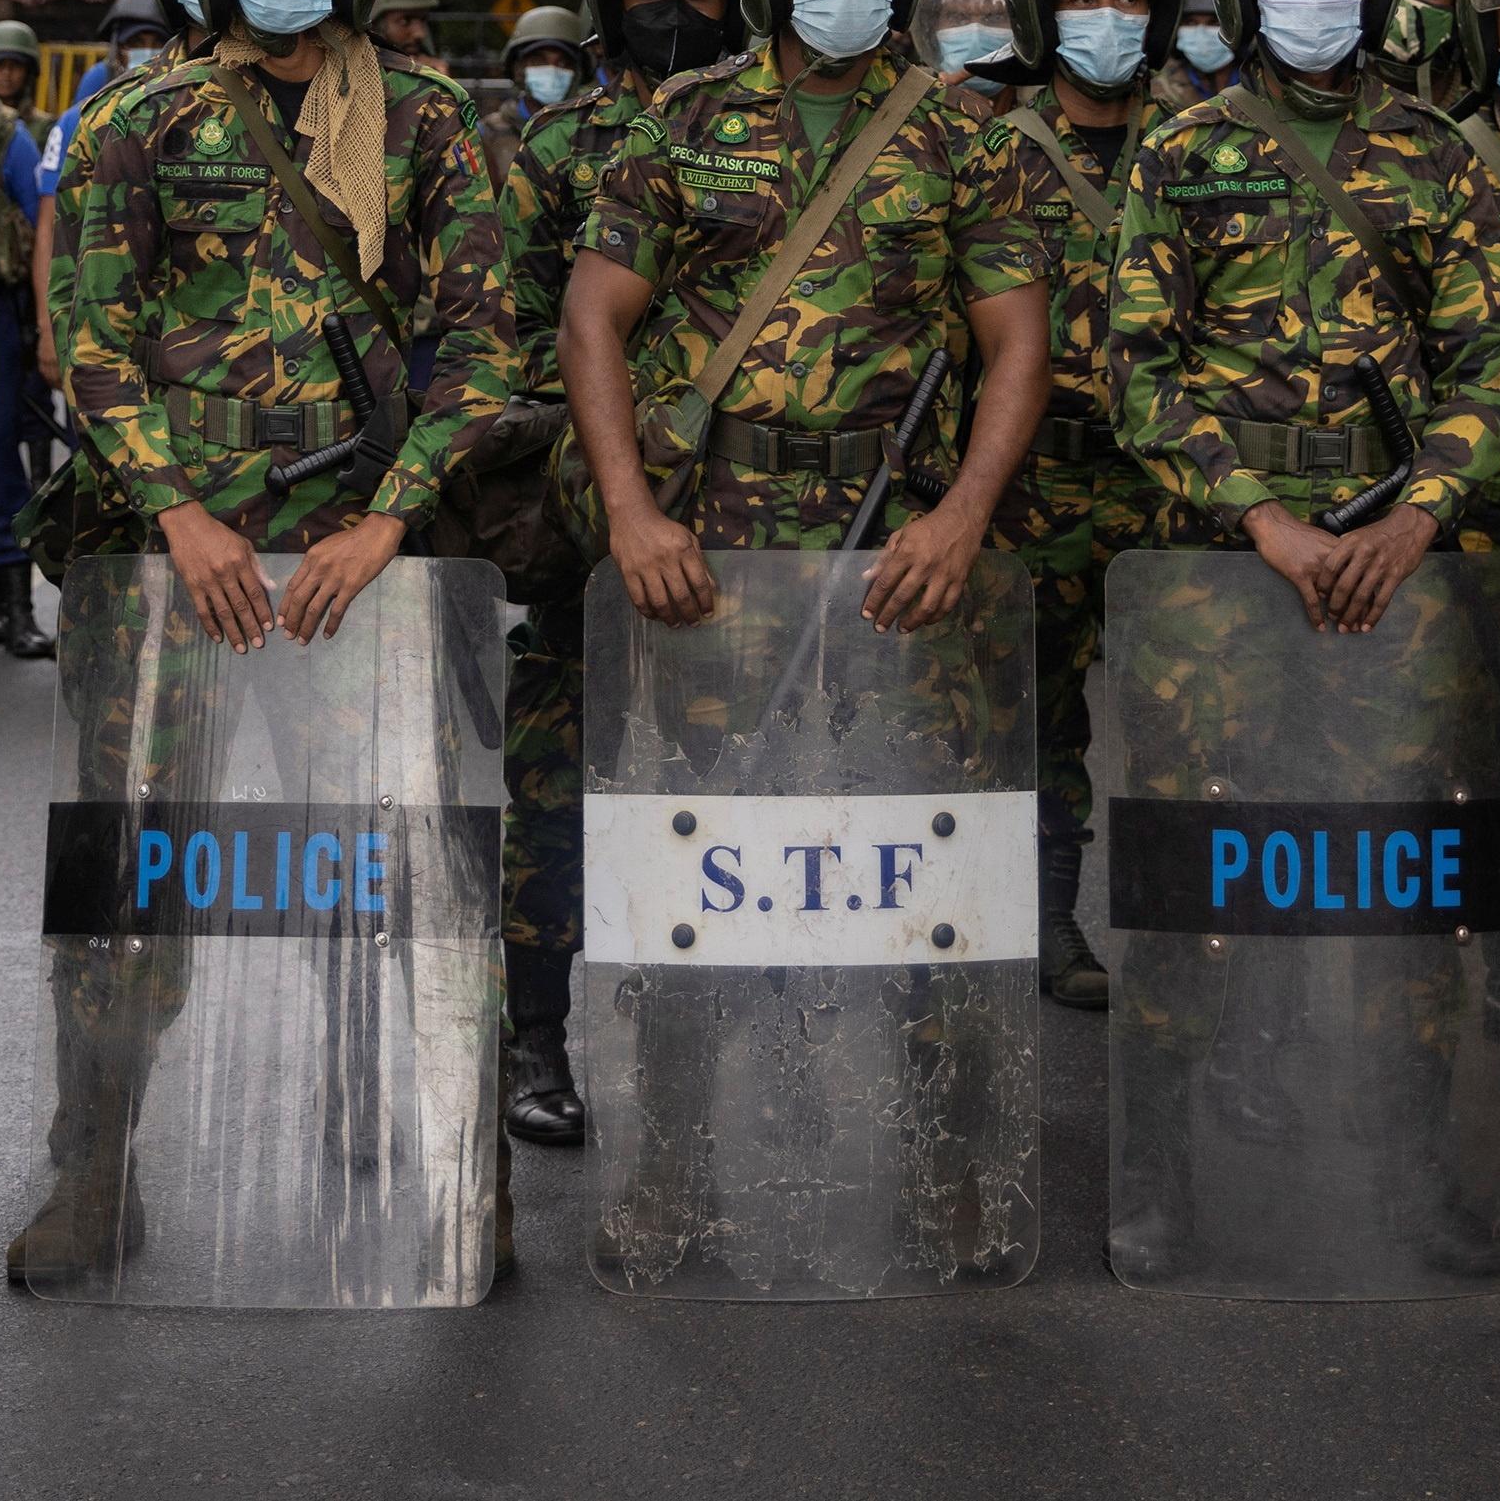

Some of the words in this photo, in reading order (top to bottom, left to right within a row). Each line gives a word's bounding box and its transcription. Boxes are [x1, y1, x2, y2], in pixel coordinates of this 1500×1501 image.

[156, 164, 192, 177] SPECIAL
[198, 164, 226, 178] TASK
[231, 166, 266, 179] FORCE
[670, 145, 712, 166] SPECIAL
[714, 155, 743, 172] TASK
[1166, 183, 1215, 198] SPECIAL
[1215, 180, 1243, 193] TASK
[1246, 179, 1286, 192] FORCE
[1034, 204, 1068, 217] FORCE
[137, 829, 389, 911] POLICE
[701, 842, 923, 914] S.T.F
[1212, 828, 1461, 910] POLICE
